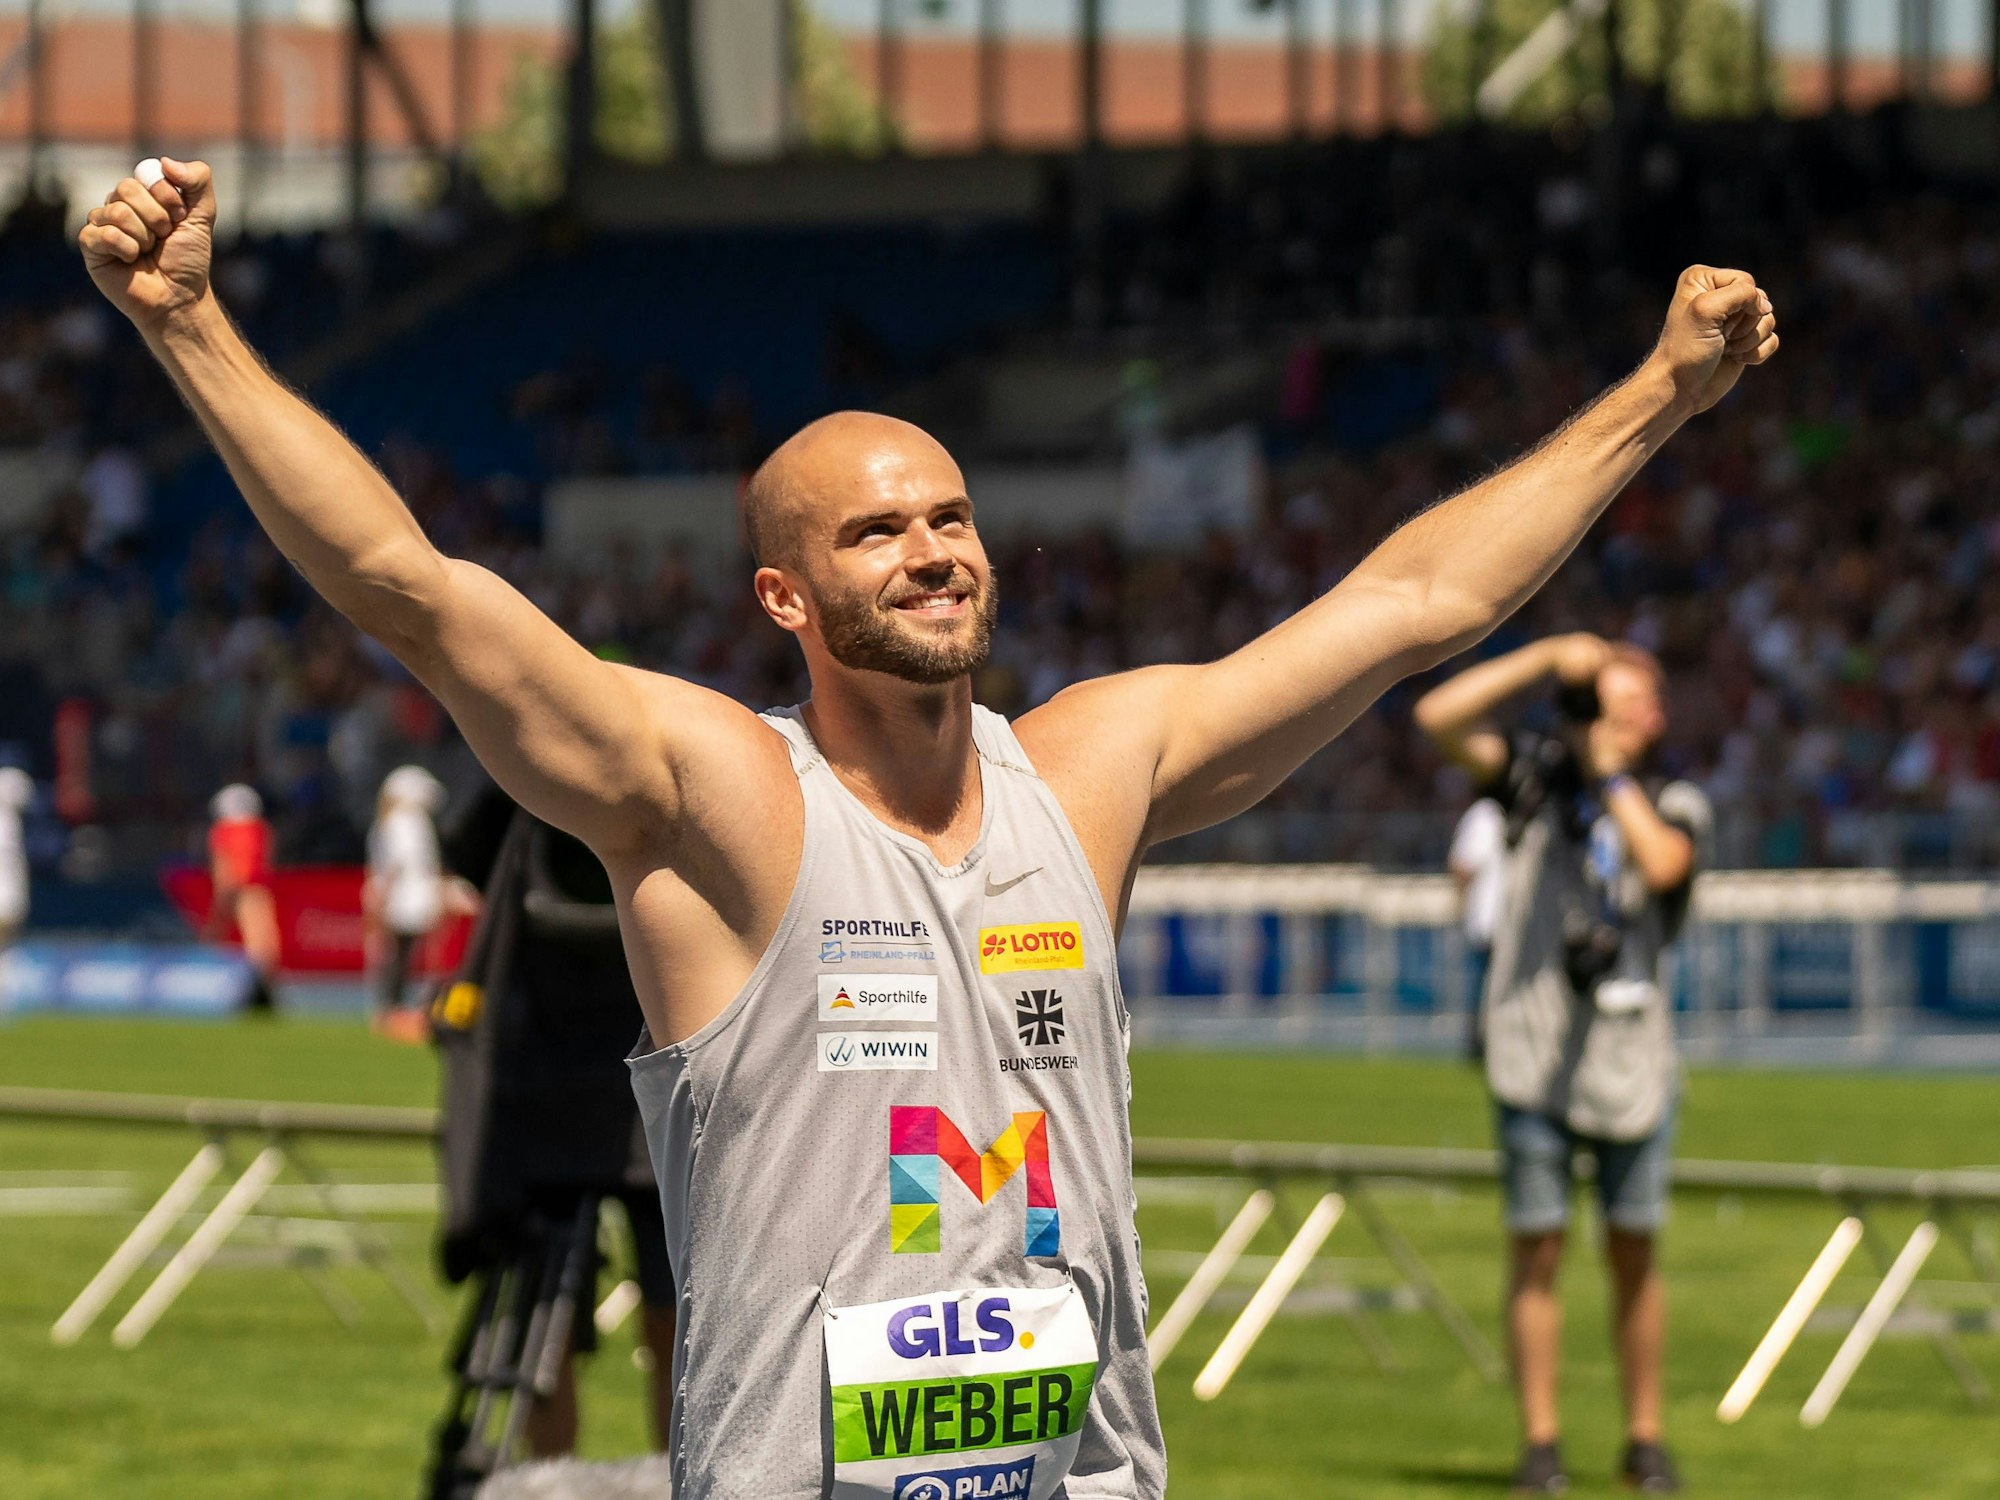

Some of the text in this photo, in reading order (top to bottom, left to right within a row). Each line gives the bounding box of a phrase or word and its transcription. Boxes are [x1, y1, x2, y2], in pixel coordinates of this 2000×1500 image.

[1010, 931, 1076, 952] LOTTO
[850, 950, 936, 960] RHEINLAND-PFALZ
[858, 990, 928, 1006] Sporthilfe
[861, 1042, 927, 1057] WIWIN
[860, 1373, 1073, 1457] WEBER
[955, 1468, 1029, 1500] PLAN
